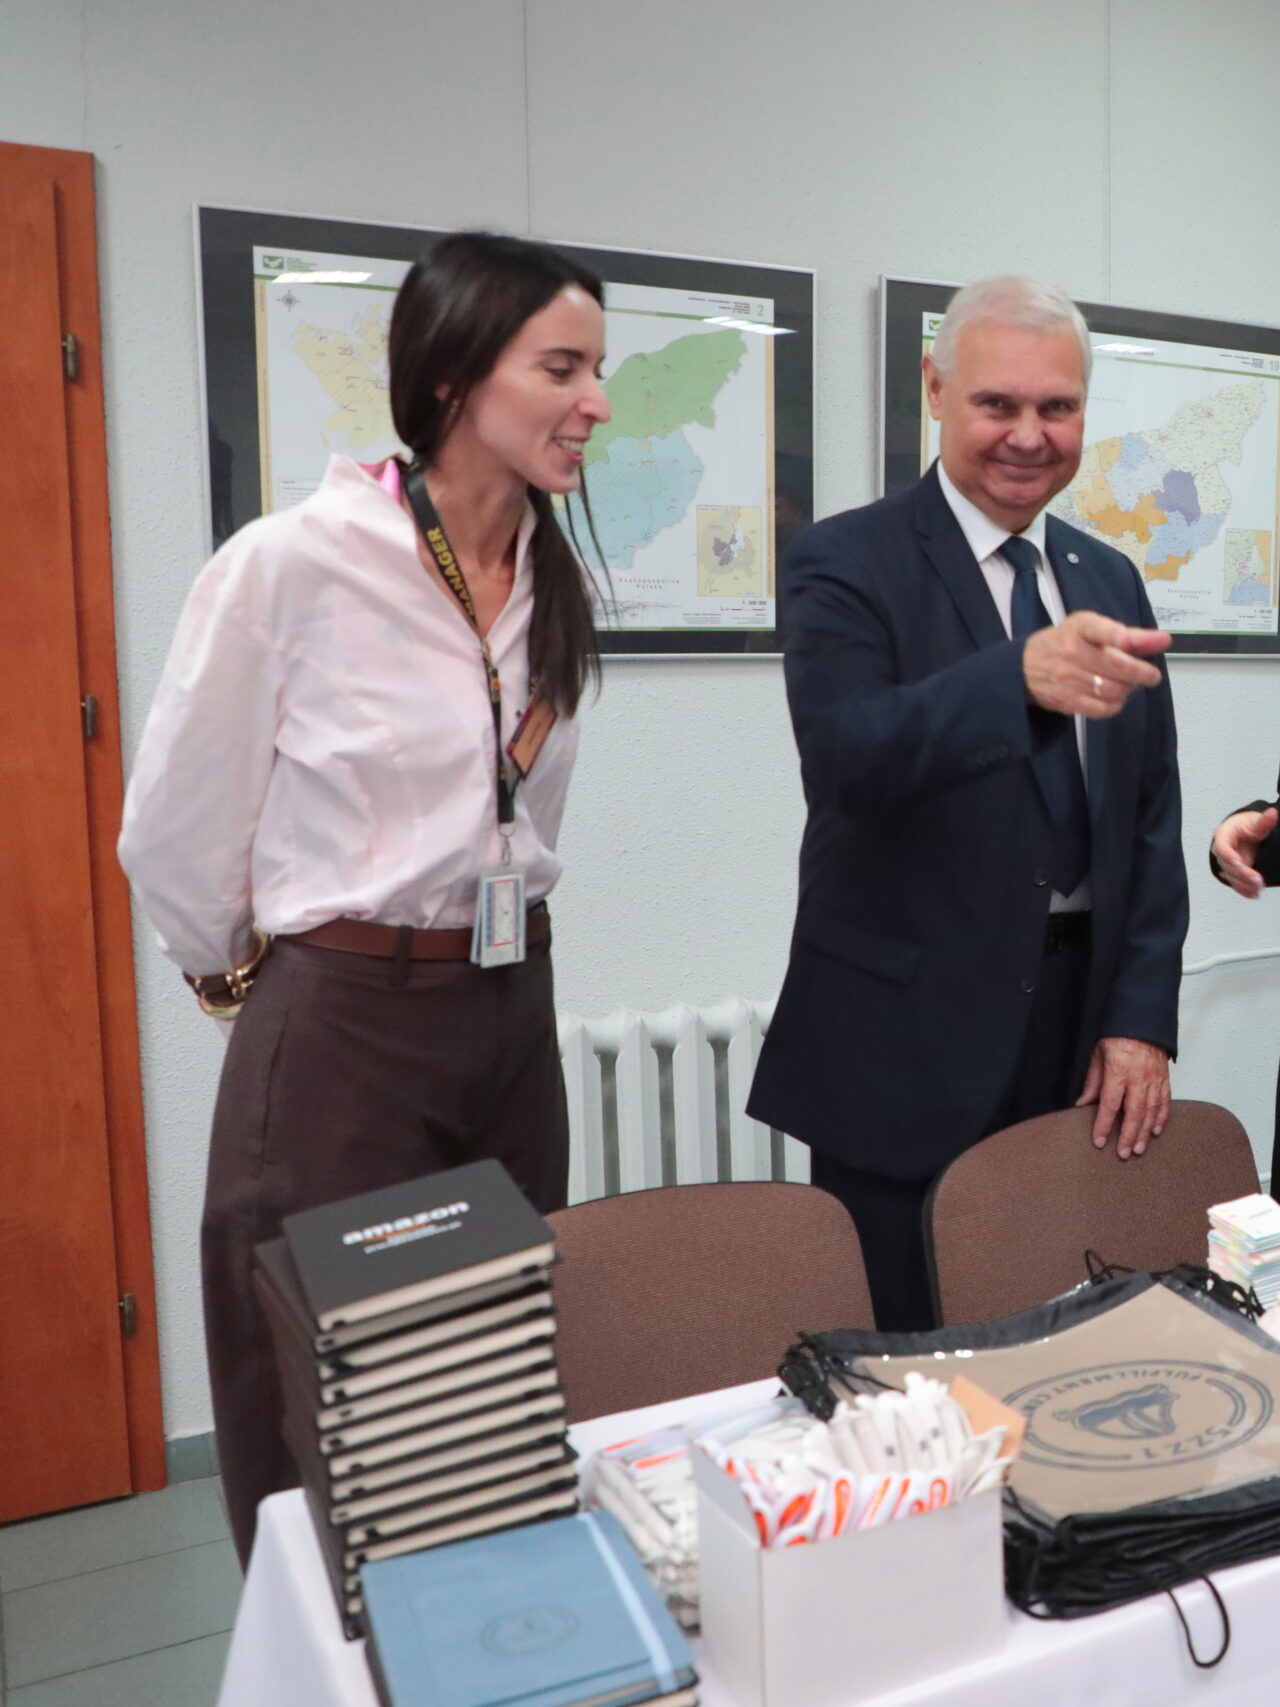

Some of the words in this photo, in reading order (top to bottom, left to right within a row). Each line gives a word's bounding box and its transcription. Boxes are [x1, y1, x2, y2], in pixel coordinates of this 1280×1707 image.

[756, 304, 765, 317] 2
[1268, 360, 1280, 372] 19
[426, 526, 476, 617] MANAGER
[341, 1200, 471, 1246] amazon
[1052, 1368, 1203, 1397] FULFILLMENT
